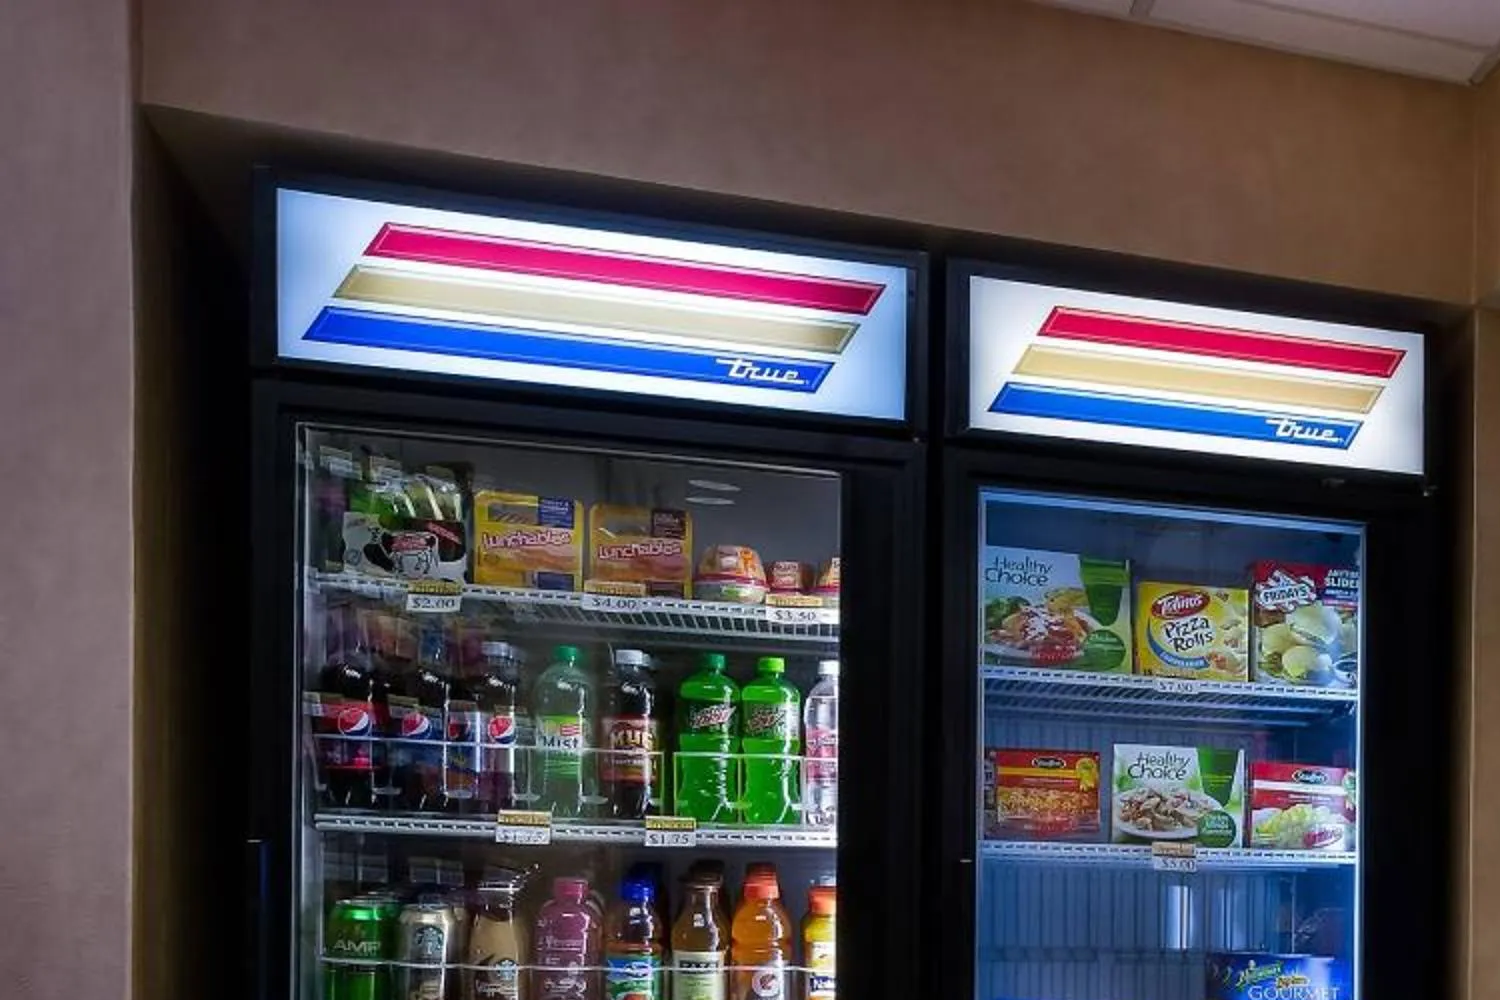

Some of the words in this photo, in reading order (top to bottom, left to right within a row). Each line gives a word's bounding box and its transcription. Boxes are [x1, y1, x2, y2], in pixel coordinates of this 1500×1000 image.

[984, 566, 1050, 587] Choice
[1163, 615, 1210, 640] Pizza
[1172, 631, 1215, 653] Rolls
[1127, 763, 1188, 781] Choice
